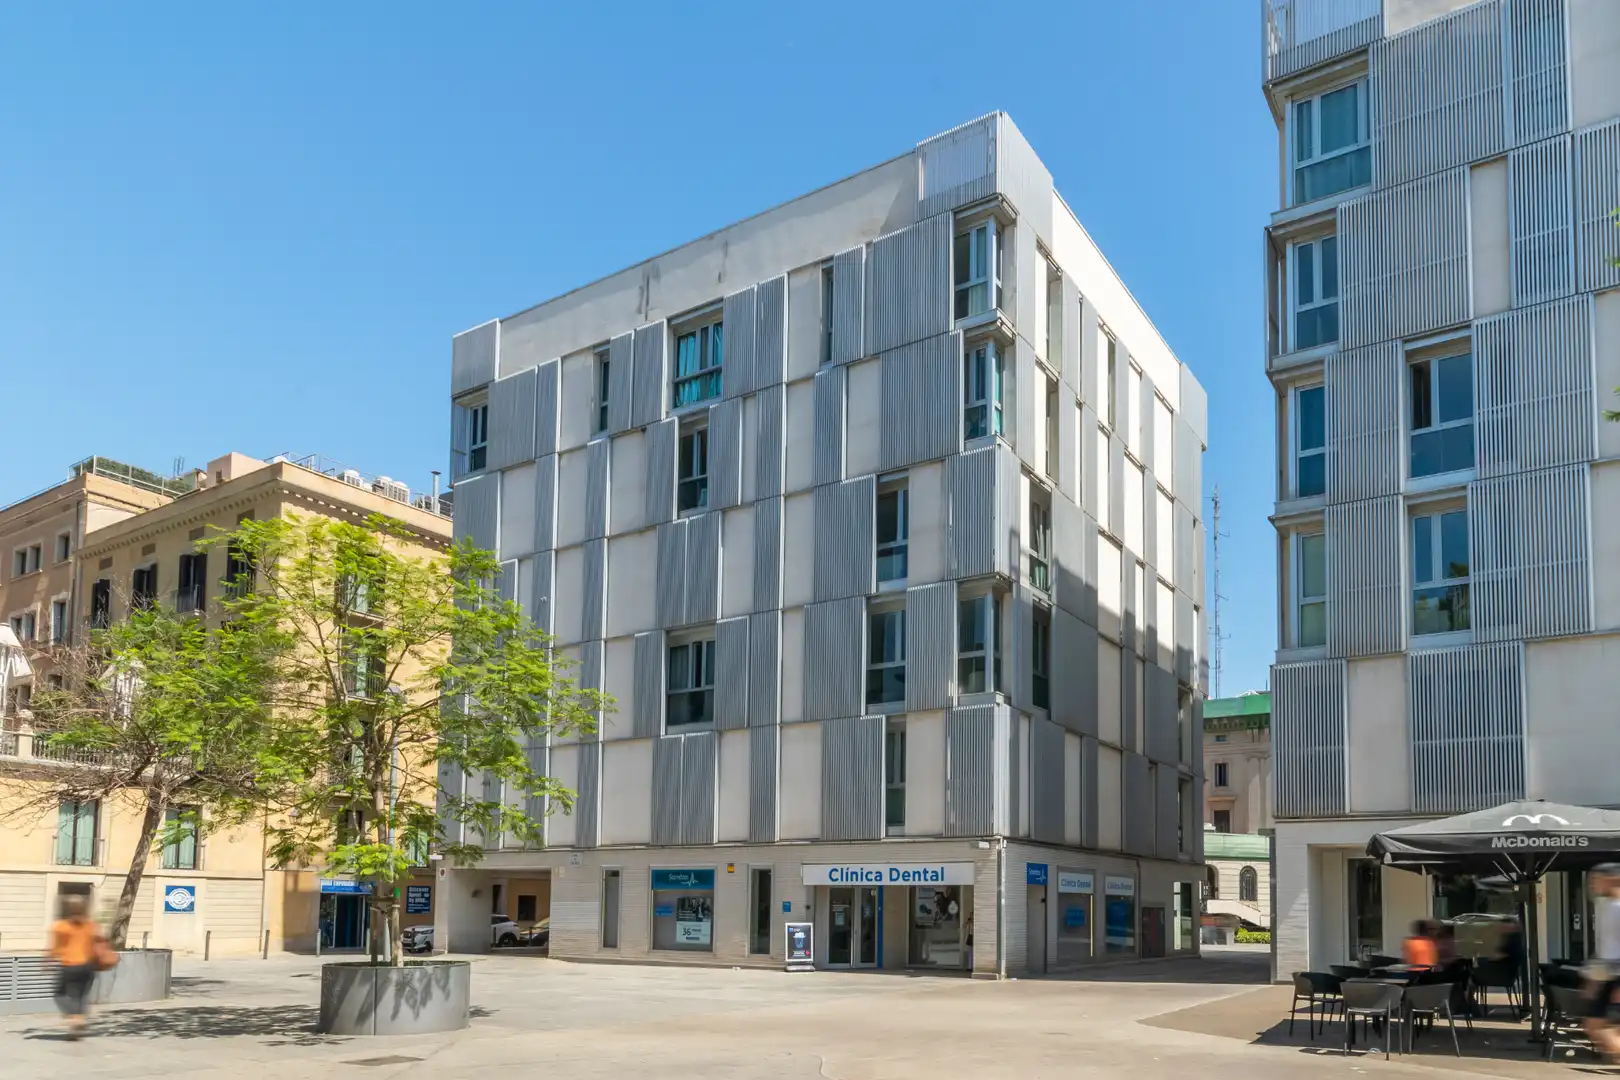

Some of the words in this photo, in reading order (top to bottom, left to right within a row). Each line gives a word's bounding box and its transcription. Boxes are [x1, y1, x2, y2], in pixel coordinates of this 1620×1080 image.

[1491, 835, 1590, 849] McDonald's
[828, 867, 883, 883] Clínica
[889, 866, 945, 882] Dental
